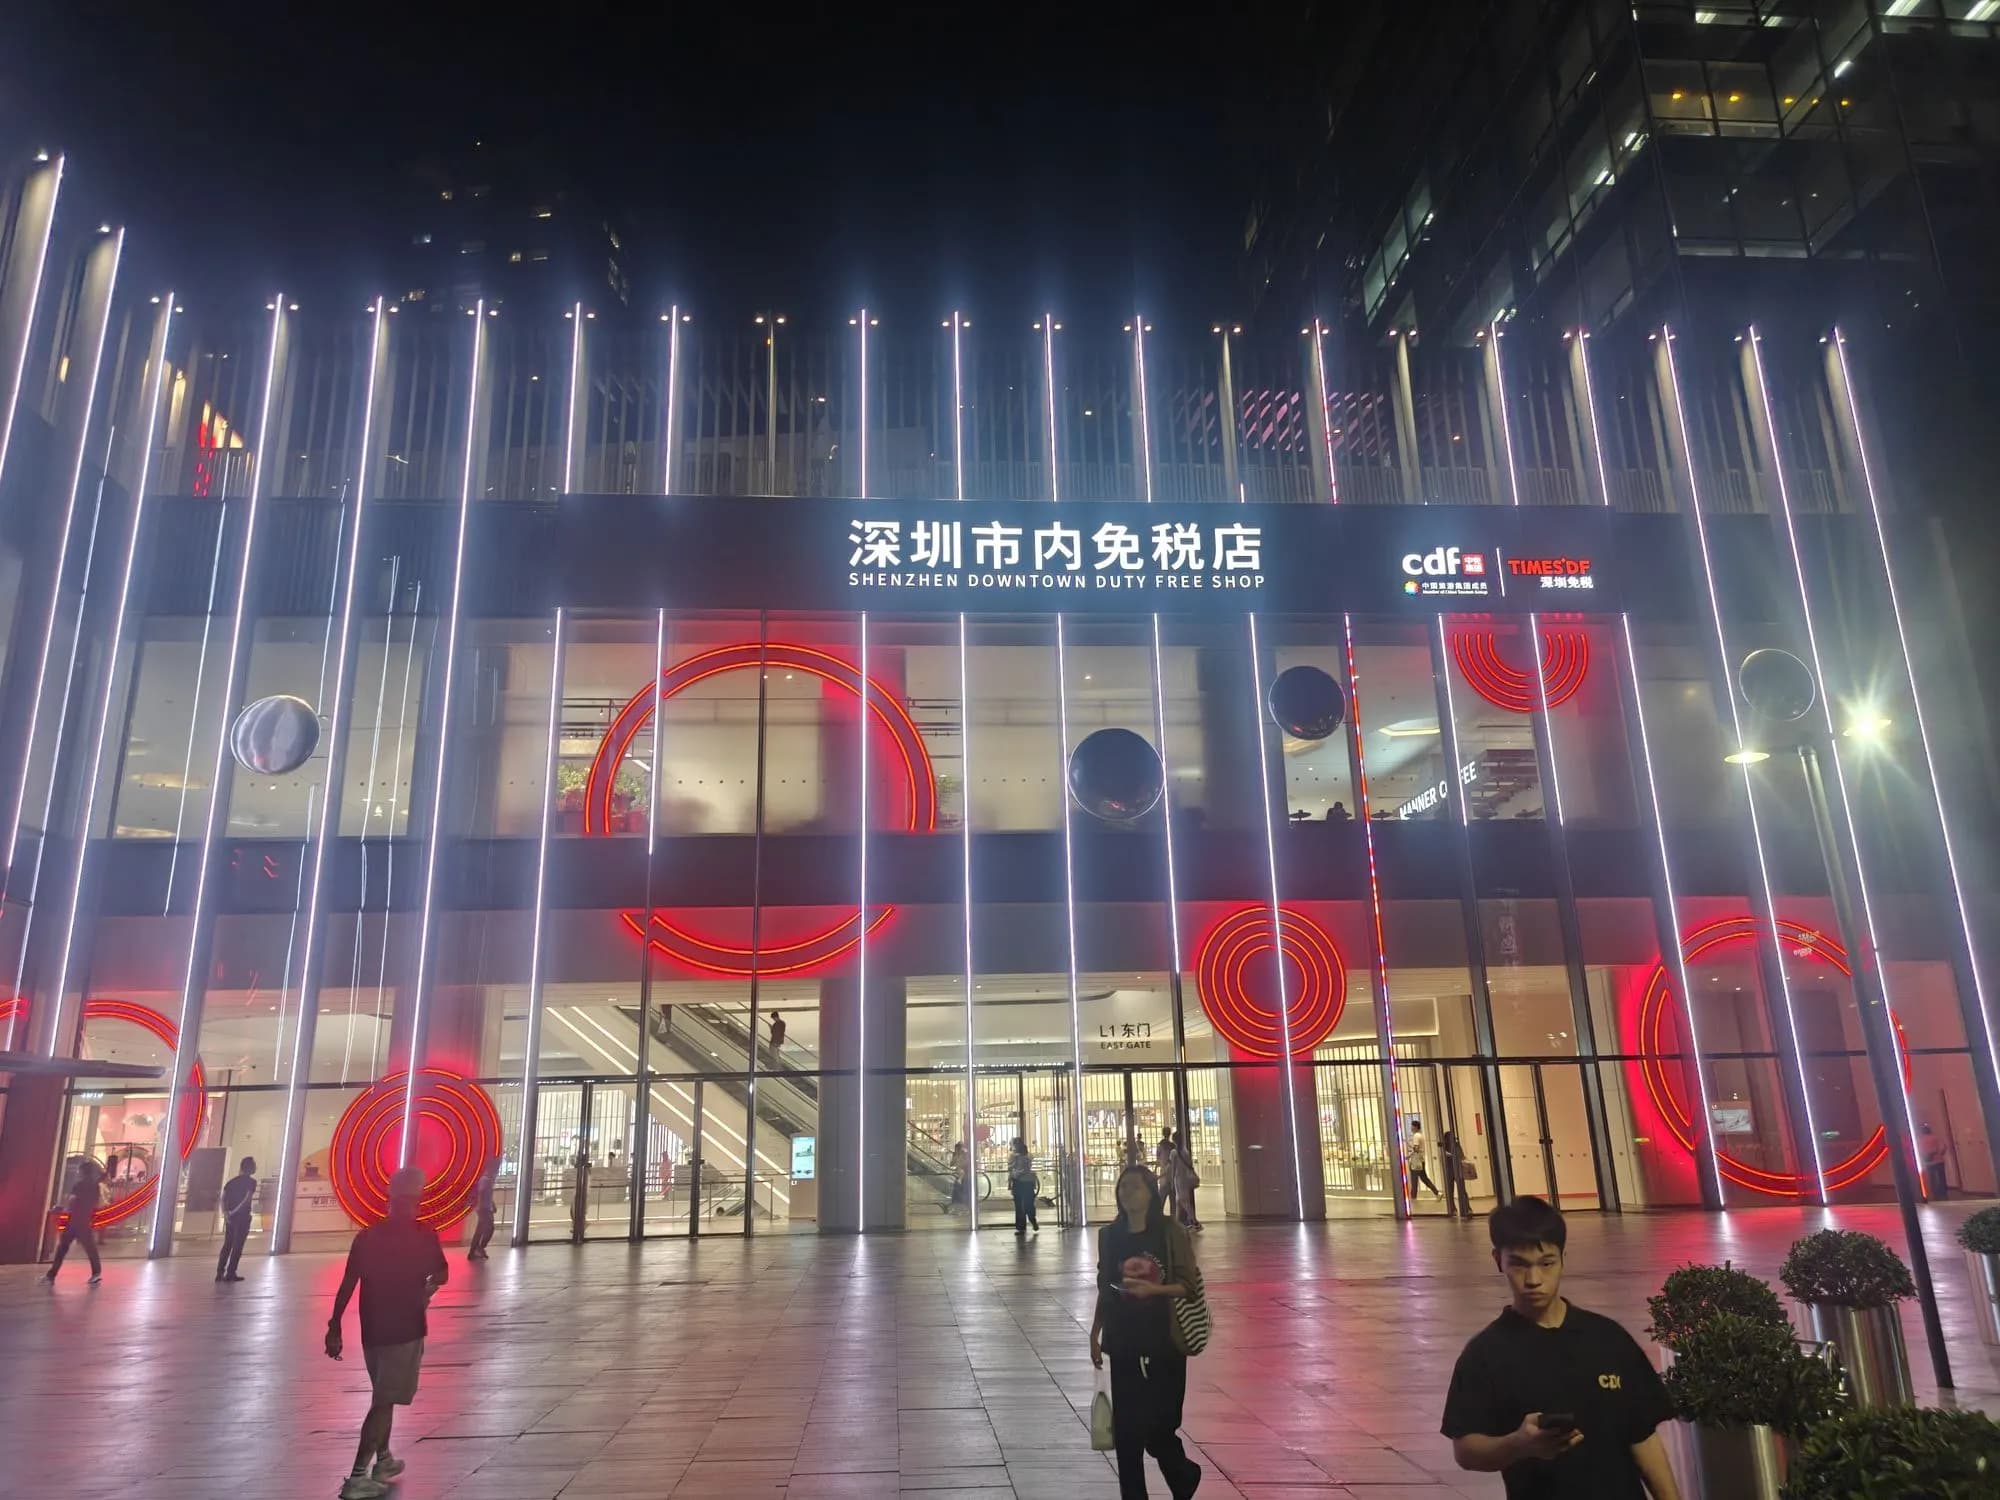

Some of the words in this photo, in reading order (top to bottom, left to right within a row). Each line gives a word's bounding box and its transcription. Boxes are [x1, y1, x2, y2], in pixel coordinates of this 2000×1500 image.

[848, 519, 1262, 571] 深圳市内免税店
[1402, 546, 1462, 576] cdf
[848, 572, 958, 587] SHENZHEN
[968, 574, 1086, 588] DOWNTOWN
[1095, 575, 1146, 589] DUTY
[1155, 575, 1203, 588] FREE
[1212, 575, 1265, 589] SHOP
[1540, 575, 1594, 589] 深圳免税
[1099, 1024, 1115, 1037] L1
[1121, 1023, 1151, 1038] 东门
[1100, 1041, 1123, 1050] EAST
[1126, 1041, 1151, 1049] GATE
